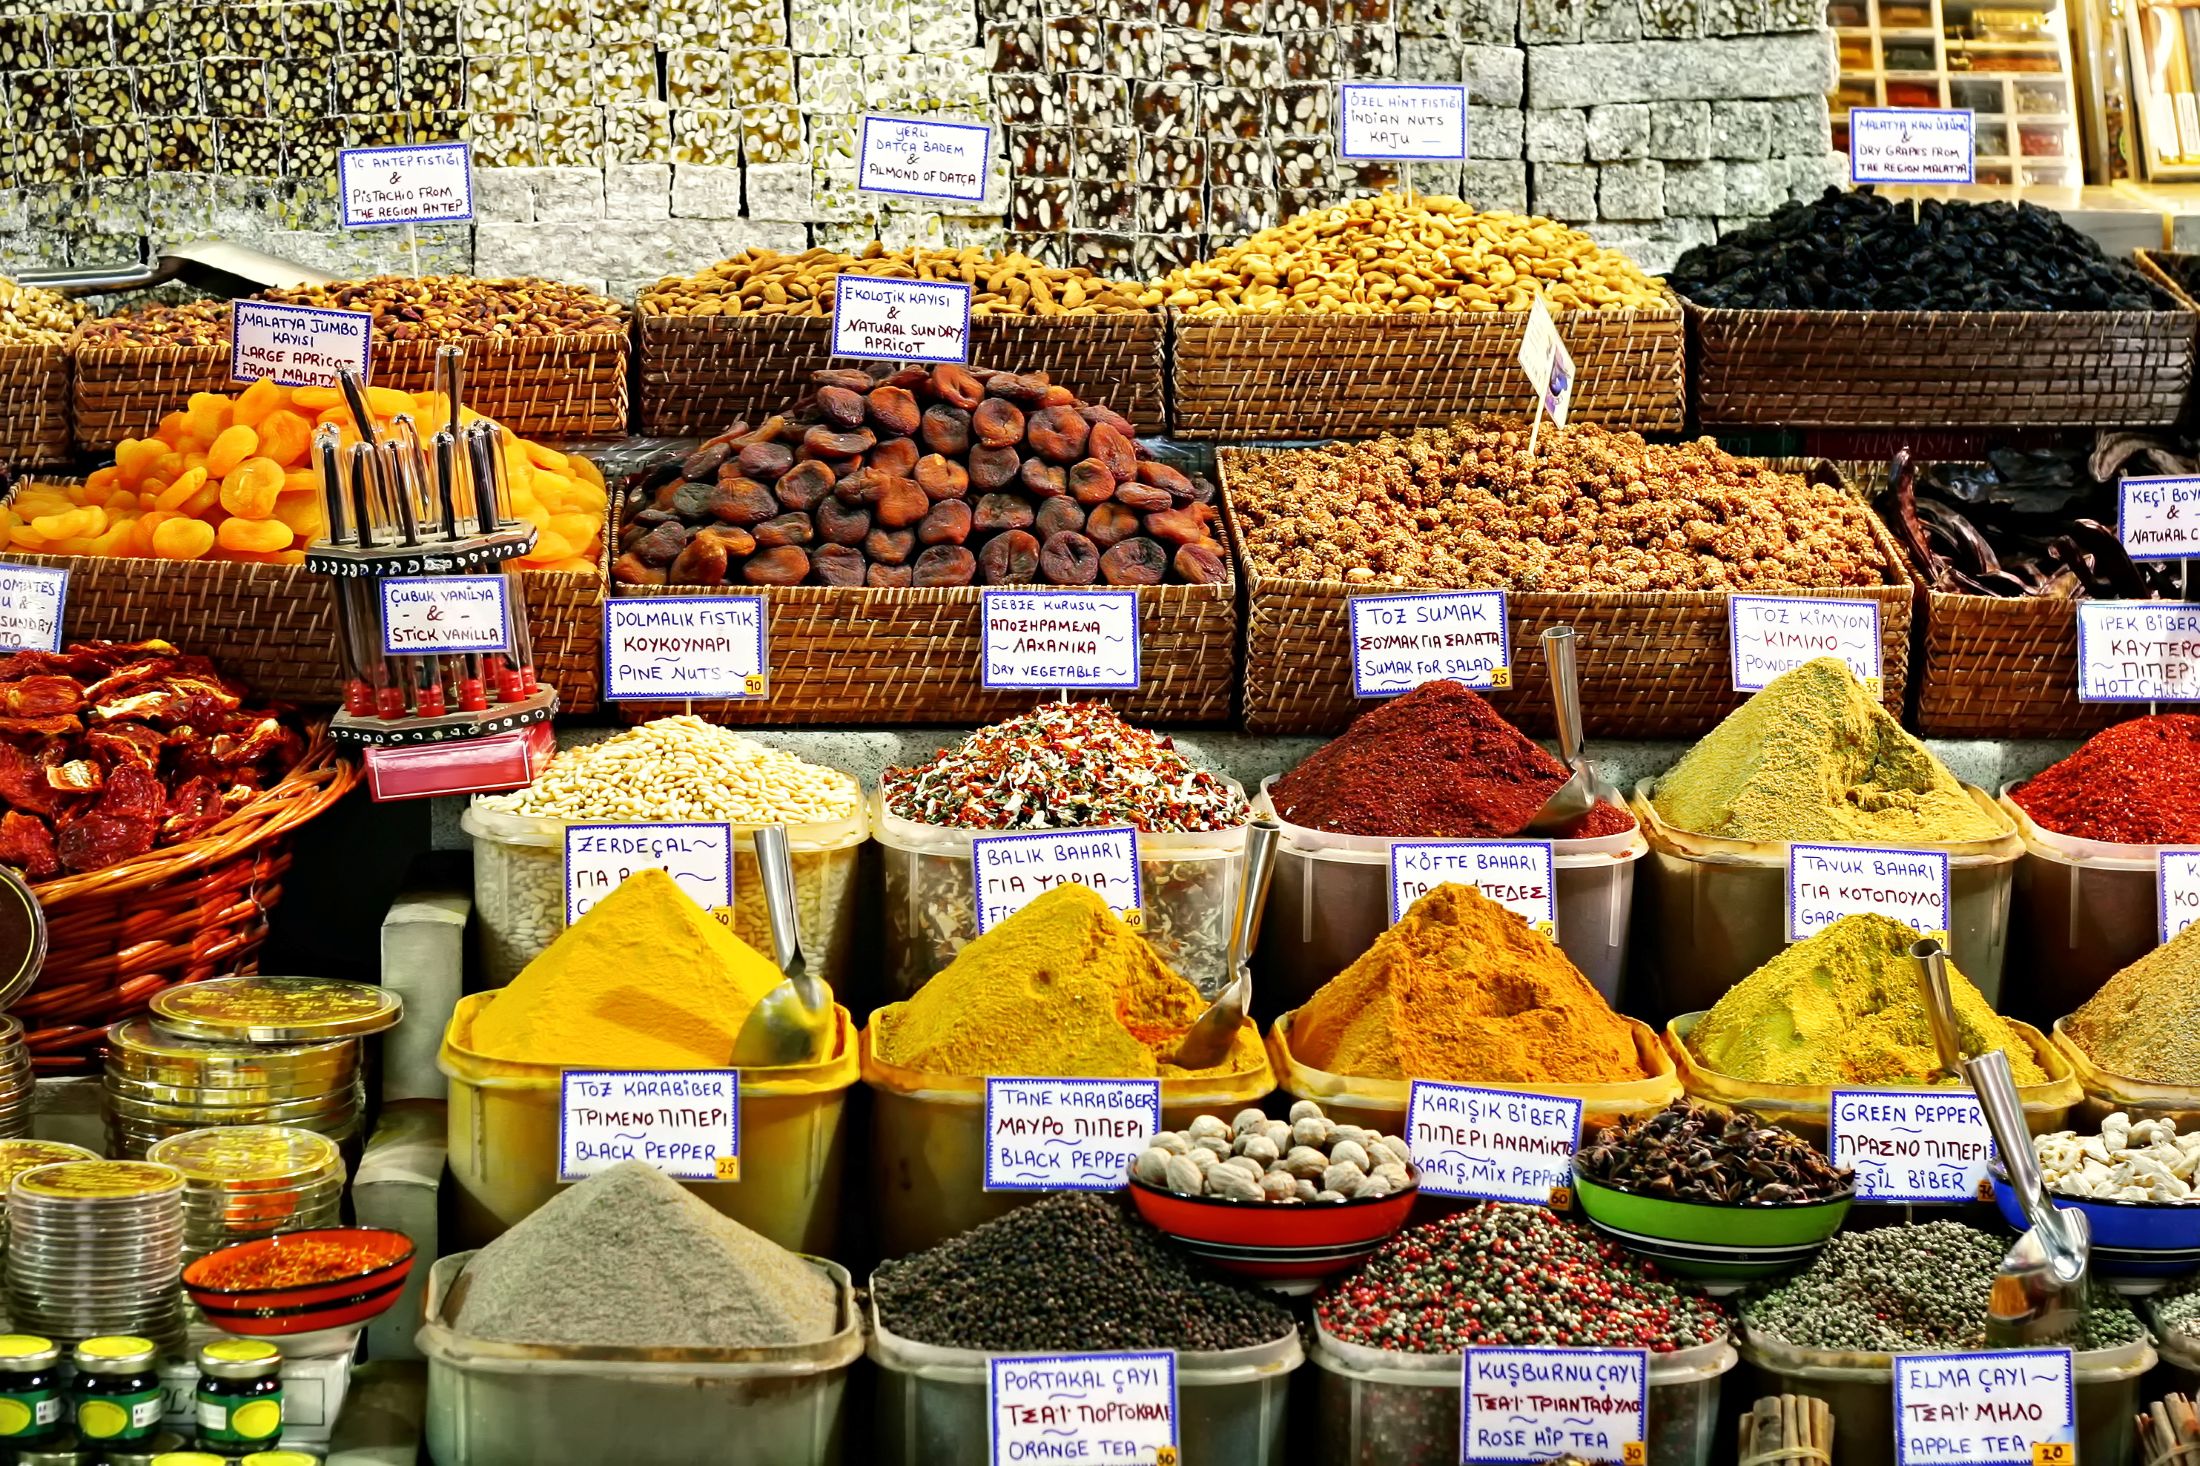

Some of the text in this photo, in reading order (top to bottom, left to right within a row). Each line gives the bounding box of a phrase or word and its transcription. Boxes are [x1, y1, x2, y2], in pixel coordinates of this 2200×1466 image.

[1408, 116, 1444, 126] NUTS
[923, 141, 964, 156] BADEM
[1370, 132, 1409, 149] KAJU
[1860, 145, 1881, 156] DRY
[1932, 147, 1960, 158] FROM
[373, 155, 413, 168] ANTEP
[1860, 163, 1878, 172] THE
[1923, 164, 1967, 174] MALATYA
[389, 171, 402, 184] &
[870, 163, 976, 186] ALMOND OF DATÇA
[419, 186, 452, 198] FROM
[352, 208, 374, 219] THE
[423, 198, 463, 214] ANTEP
[910, 293, 950, 307] KAYISI
[887, 306, 900, 319] &
[241, 312, 358, 336] MALATYA JUMBO
[843, 319, 906, 335] NATURAL
[273, 331, 314, 347] KAYISI
[241, 345, 285, 362] LARGE
[242, 362, 336, 386] FROM MALATY
[2172, 488, 2200, 502] BOY
[2167, 505, 2179, 519] &
[2129, 528, 2187, 544] NATURAL
[0, 579, 55, 596] OMATES
[391, 589, 434, 608] ÇUBUK
[991, 598, 1096, 611] SEBZE KURUSU
[427, 605, 444, 620] &
[616, 611, 754, 627] DOLMALIK FISTIK
[1366, 604, 1486, 624] TOZ SUMAK
[1748, 606, 1789, 624] TOZ
[1422, 635, 1441, 648] ΓΙΑ
[619, 664, 721, 680] PINE NUTS
[993, 664, 1100, 678] DRY VEGETABLE
[1365, 658, 1494, 676] SUMAK FOR SALAD
[745, 680, 761, 691] 90
[1492, 673, 1507, 685] 25
[2095, 677, 2134, 696] HOT
[578, 836, 692, 858] ZERDEÇAL
[988, 842, 1121, 865] BALIK BAHARI
[1405, 851, 1536, 871] KÖFTE BAHARI
[1802, 856, 1934, 881] TAVUK BAHARI
[988, 876, 1025, 894] ΓΙΑ
[1801, 884, 1830, 899] ΓΙΑ
[1126, 915, 1140, 926] 40
[574, 1082, 612, 1097] TOZ
[999, 1089, 1053, 1107] TANE
[1422, 1094, 1502, 1124] KARIŞIK
[1842, 1103, 1982, 1127] GREEN PEPPER
[576, 1141, 716, 1160] BLACK PEPPER
[1001, 1148, 1060, 1168] BLACK
[719, 1162, 734, 1174] 25
[1512, 1166, 1567, 1187] PEPPER
[1551, 1191, 1568, 1204] 60
[1004, 1368, 1158, 1394] PORTAKAL ÇAYI
[1478, 1361, 1638, 1392] KUŞBURNU ÇAYI
[1910, 1367, 2026, 1393] ELMA ÇAYI
[1478, 1428, 1526, 1447] ROSE
[1569, 1431, 1609, 1449] TEA
[1911, 1435, 2026, 1456] APPLE TEA
[1009, 1440, 1137, 1461] ORANGE TEA
[1624, 1446, 1642, 1460] 30
[2041, 1446, 2063, 1460] 20
